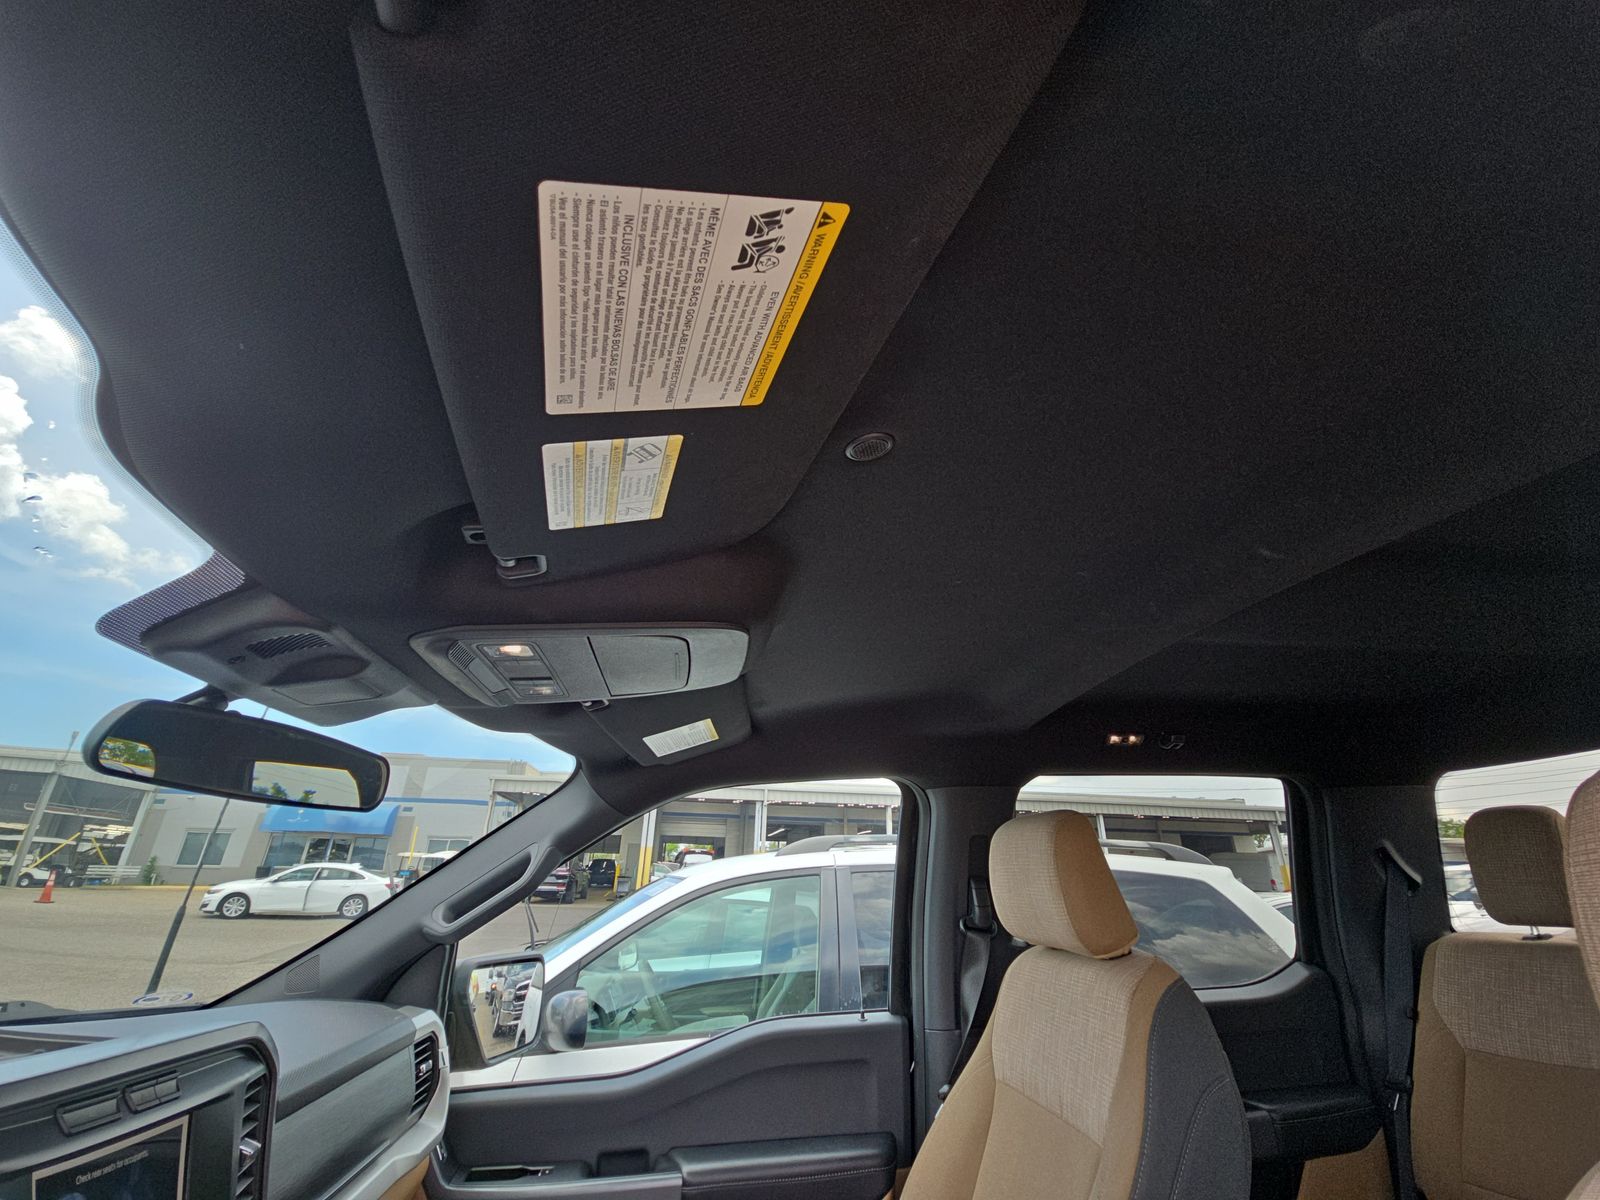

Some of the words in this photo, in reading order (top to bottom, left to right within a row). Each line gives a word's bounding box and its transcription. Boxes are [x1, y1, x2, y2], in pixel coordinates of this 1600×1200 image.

[570, 197, 581, 228] Siempre
[585, 199, 595, 222] Nunca
[598, 208, 608, 235] asiento
[650, 204, 662, 238] Consultez
[639, 215, 648, 231] sacs
[669, 216, 683, 239] placez
[703, 207, 722, 237] MÊME
[582, 223, 594, 250] coloque
[619, 214, 634, 266] INCLUSIVE
[655, 232, 669, 258] toujours
[596, 236, 606, 260] trasero
[646, 246, 656, 264] Guide
[697, 238, 712, 263] AVEC
[797, 233, 826, 279] WARNING
[616, 268, 628, 287] CON
[670, 276, 681, 291] place
[692, 265, 706, 283] DES
[581, 285, 590, 296] tipo
[615, 290, 626, 306] LAS
[687, 285, 701, 306] SACS
[722, 284, 735, 303] Always
[735, 284, 746, 298] Never
[764, 291, 780, 310] EVEN
[611, 308, 624, 337] NUEVAS
[676, 308, 695, 354] GONFLABLES
[757, 312, 771, 330] WITH
[609, 339, 620, 366] BOLSAS
[743, 331, 764, 365] ADVANCED
[608, 367, 617, 376] DE
[739, 366, 750, 376] AIR
[606, 376, 616, 391] AIRE
[733, 376, 746, 392] BAGS
